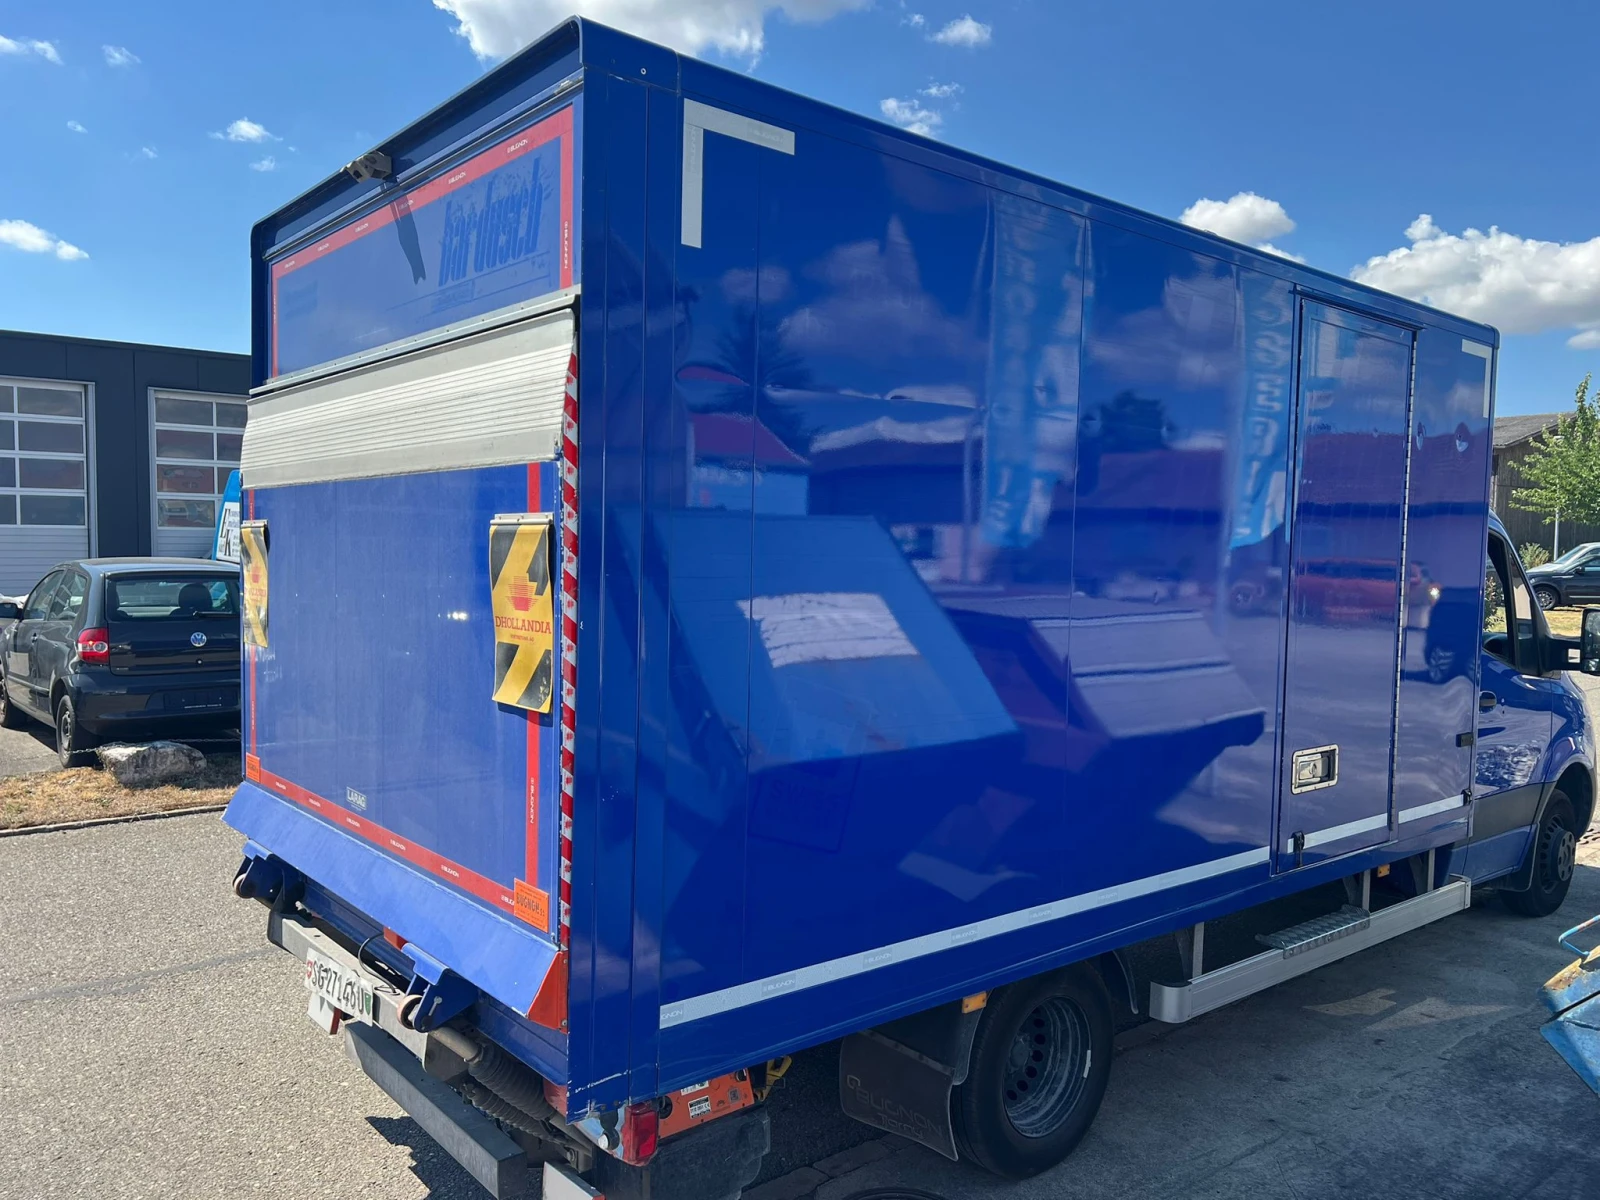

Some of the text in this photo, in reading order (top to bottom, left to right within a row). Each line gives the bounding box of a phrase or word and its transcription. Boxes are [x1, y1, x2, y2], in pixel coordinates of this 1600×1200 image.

[495, 616, 552, 634] DHOLLANDIA
[347, 789, 366, 808] LARAG
[856, 1087, 942, 1136] BUGNON
